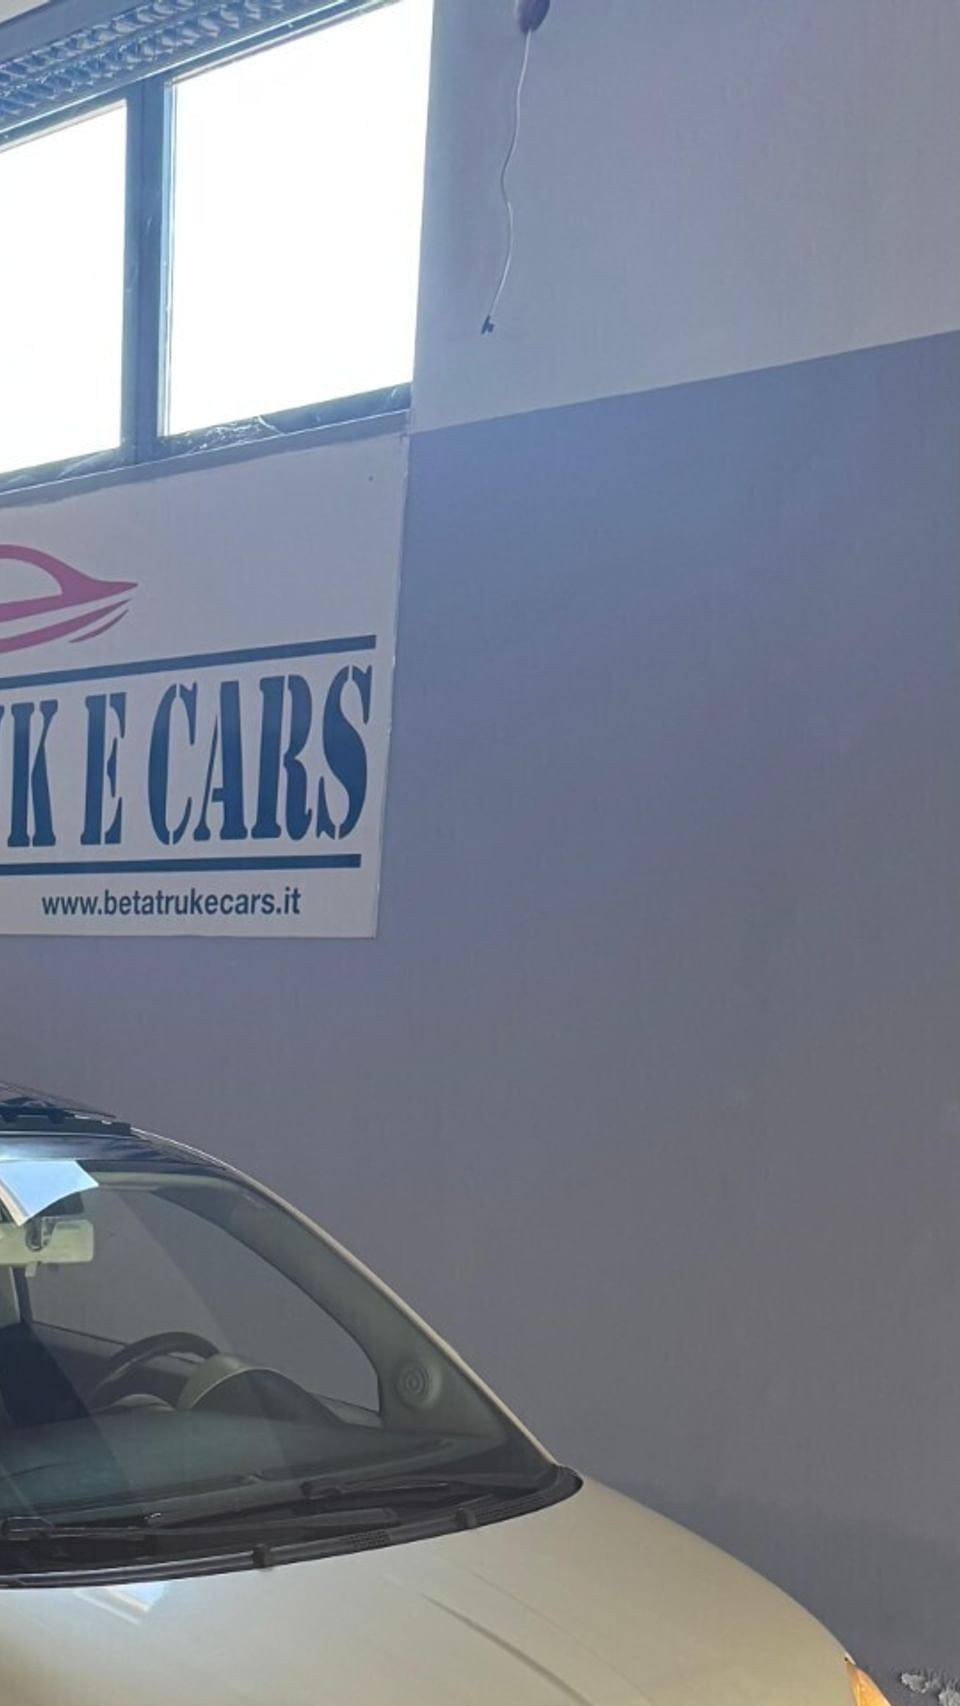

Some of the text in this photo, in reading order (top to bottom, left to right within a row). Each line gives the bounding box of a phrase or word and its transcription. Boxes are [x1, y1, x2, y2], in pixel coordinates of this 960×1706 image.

[80, 691, 127, 846] E
[148, 664, 373, 846] CARS
[41, 888, 302, 917] www.betatrukecars.it
